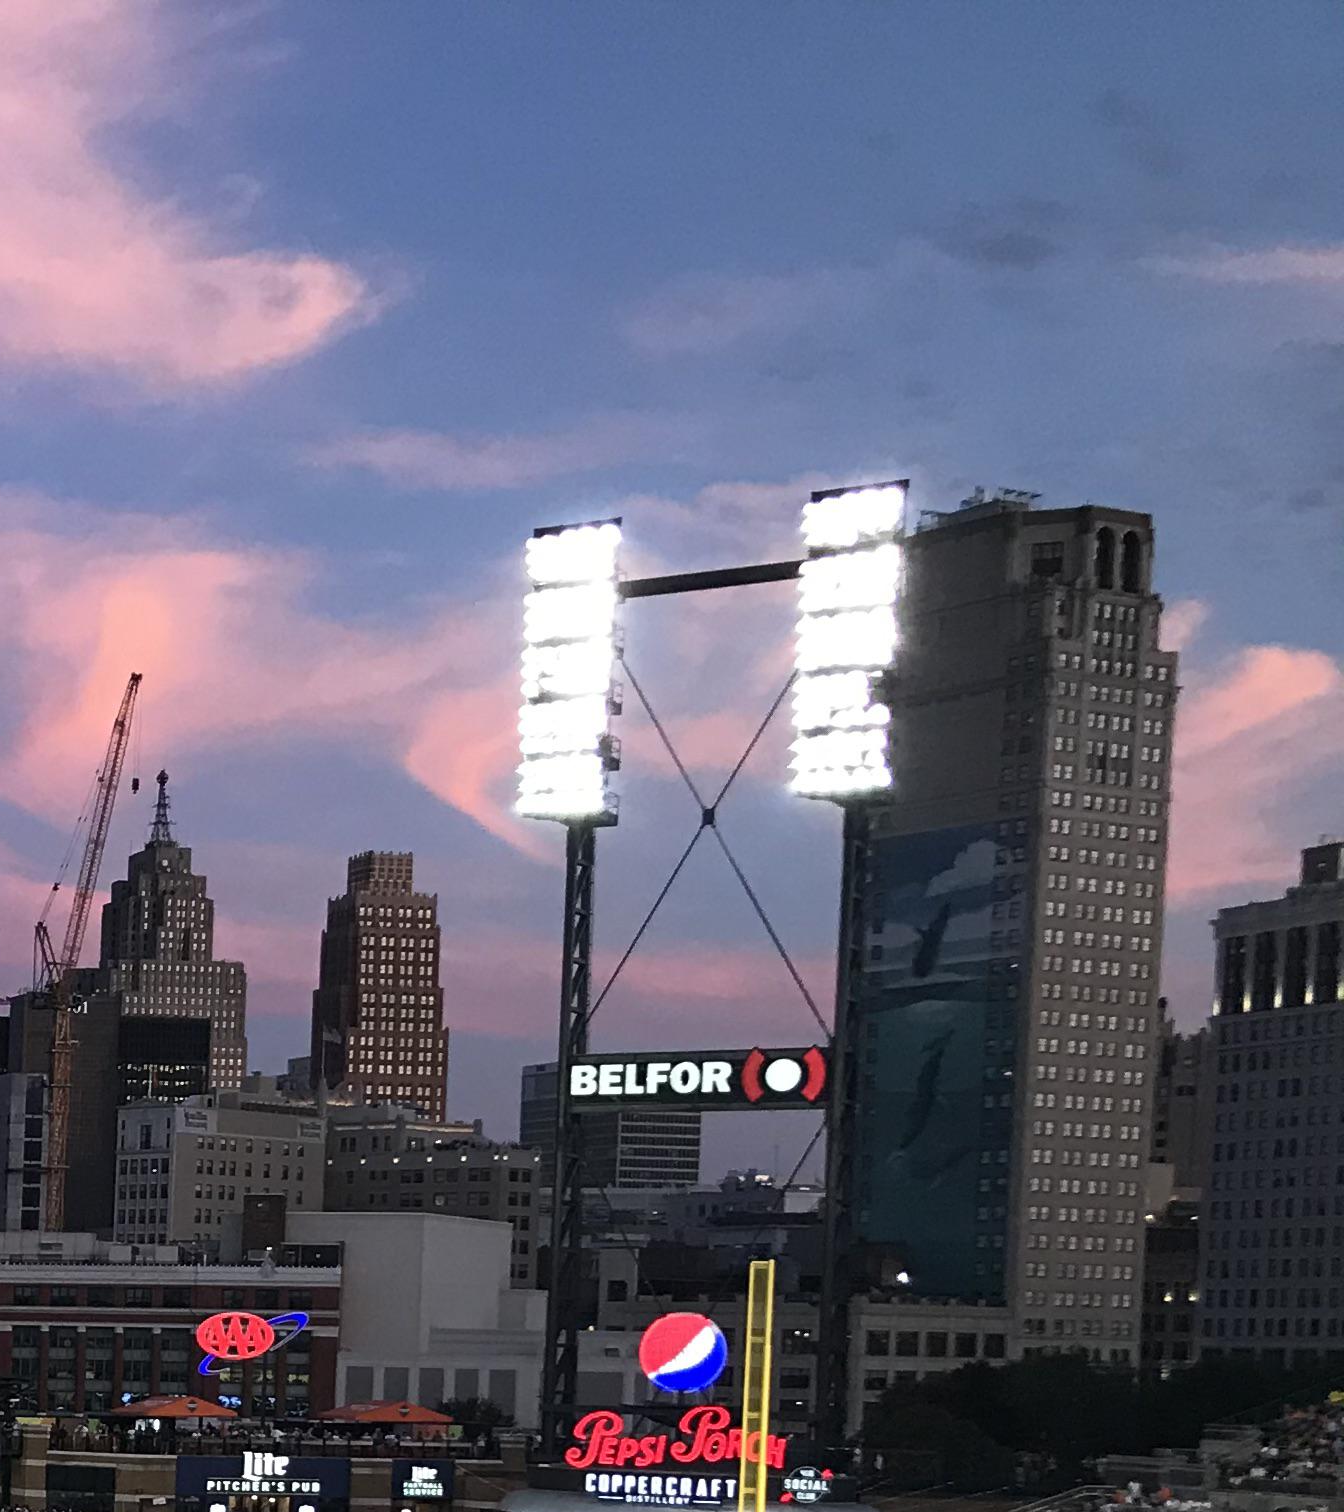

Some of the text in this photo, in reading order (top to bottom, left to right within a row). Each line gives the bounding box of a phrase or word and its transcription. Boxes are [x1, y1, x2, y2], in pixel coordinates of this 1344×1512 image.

[569, 1060, 733, 1096] BELFOR
[203, 1315, 269, 1357] AAA
[241, 1451, 290, 1481] Lite
[206, 1480, 321, 1493] PITCHER'S PUB
[585, 1473, 737, 1498] COPPERCRAFT
[783, 1478, 829, 1491] SOCIAL
